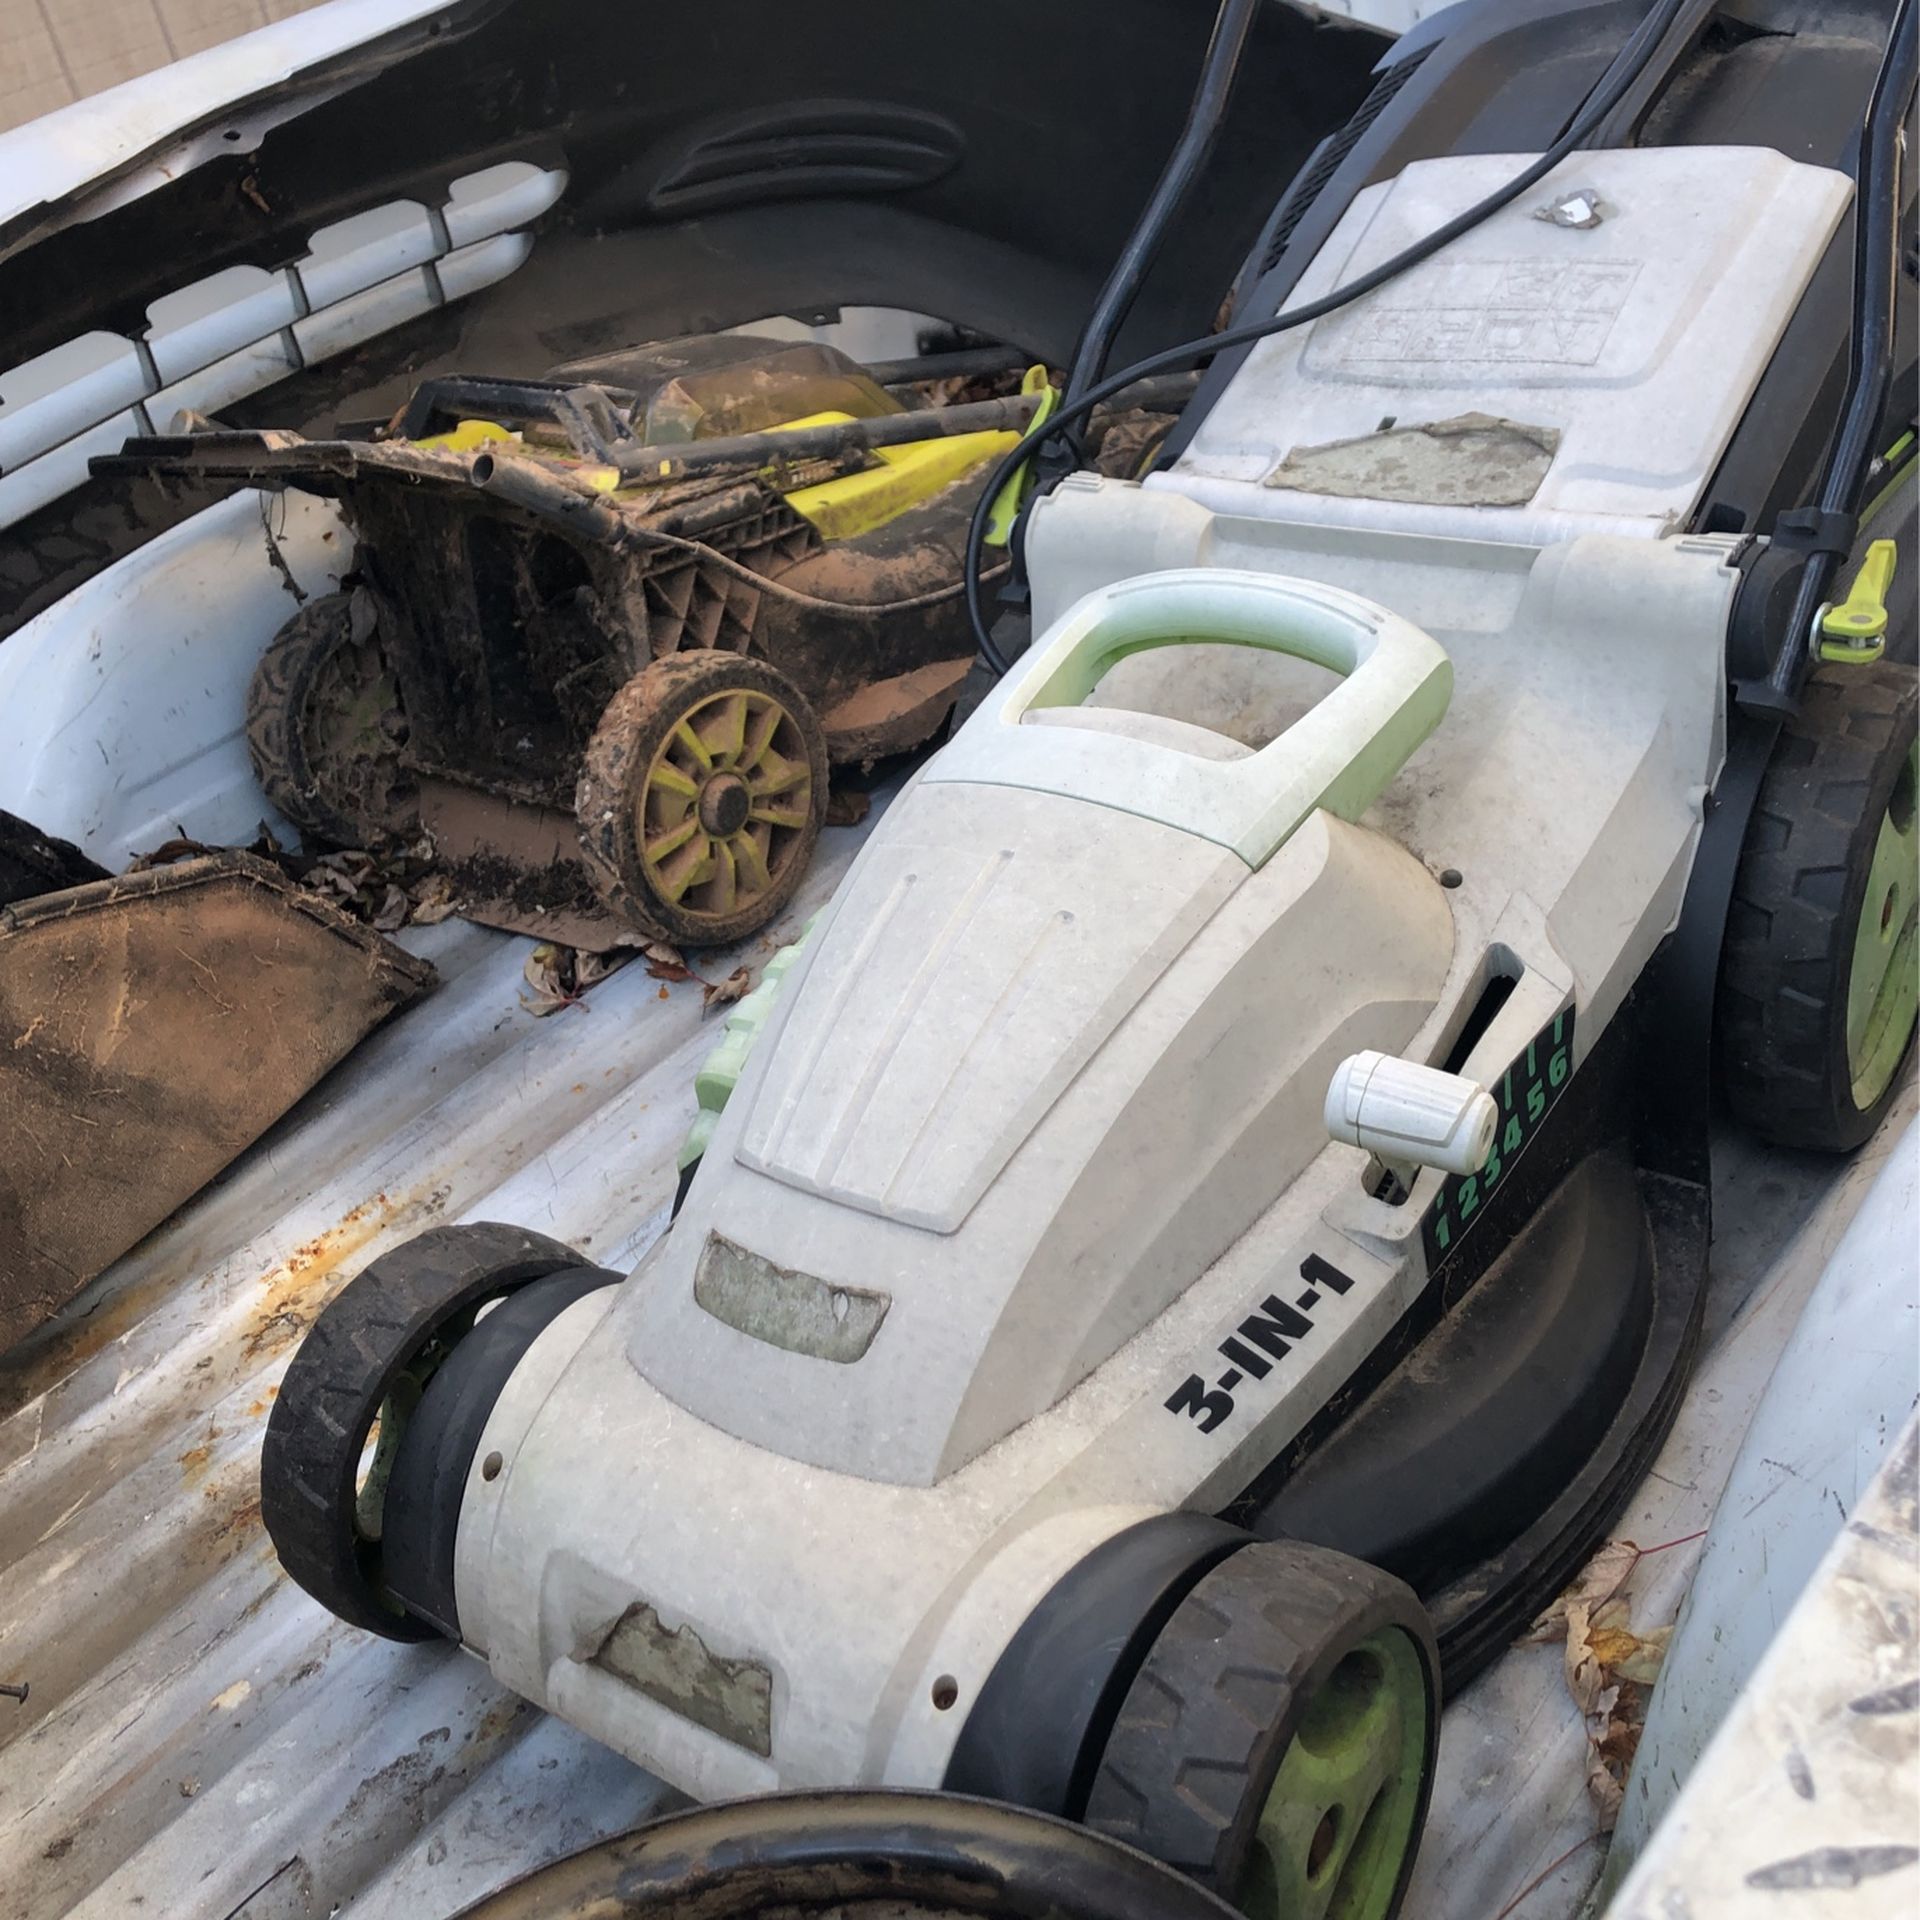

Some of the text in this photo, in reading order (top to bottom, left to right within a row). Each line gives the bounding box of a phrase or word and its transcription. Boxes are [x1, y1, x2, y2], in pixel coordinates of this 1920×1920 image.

[1435, 1045, 1567, 1249] 1 2 3 4 5 6
[1163, 1252, 1355, 1434] 3-IN-1
